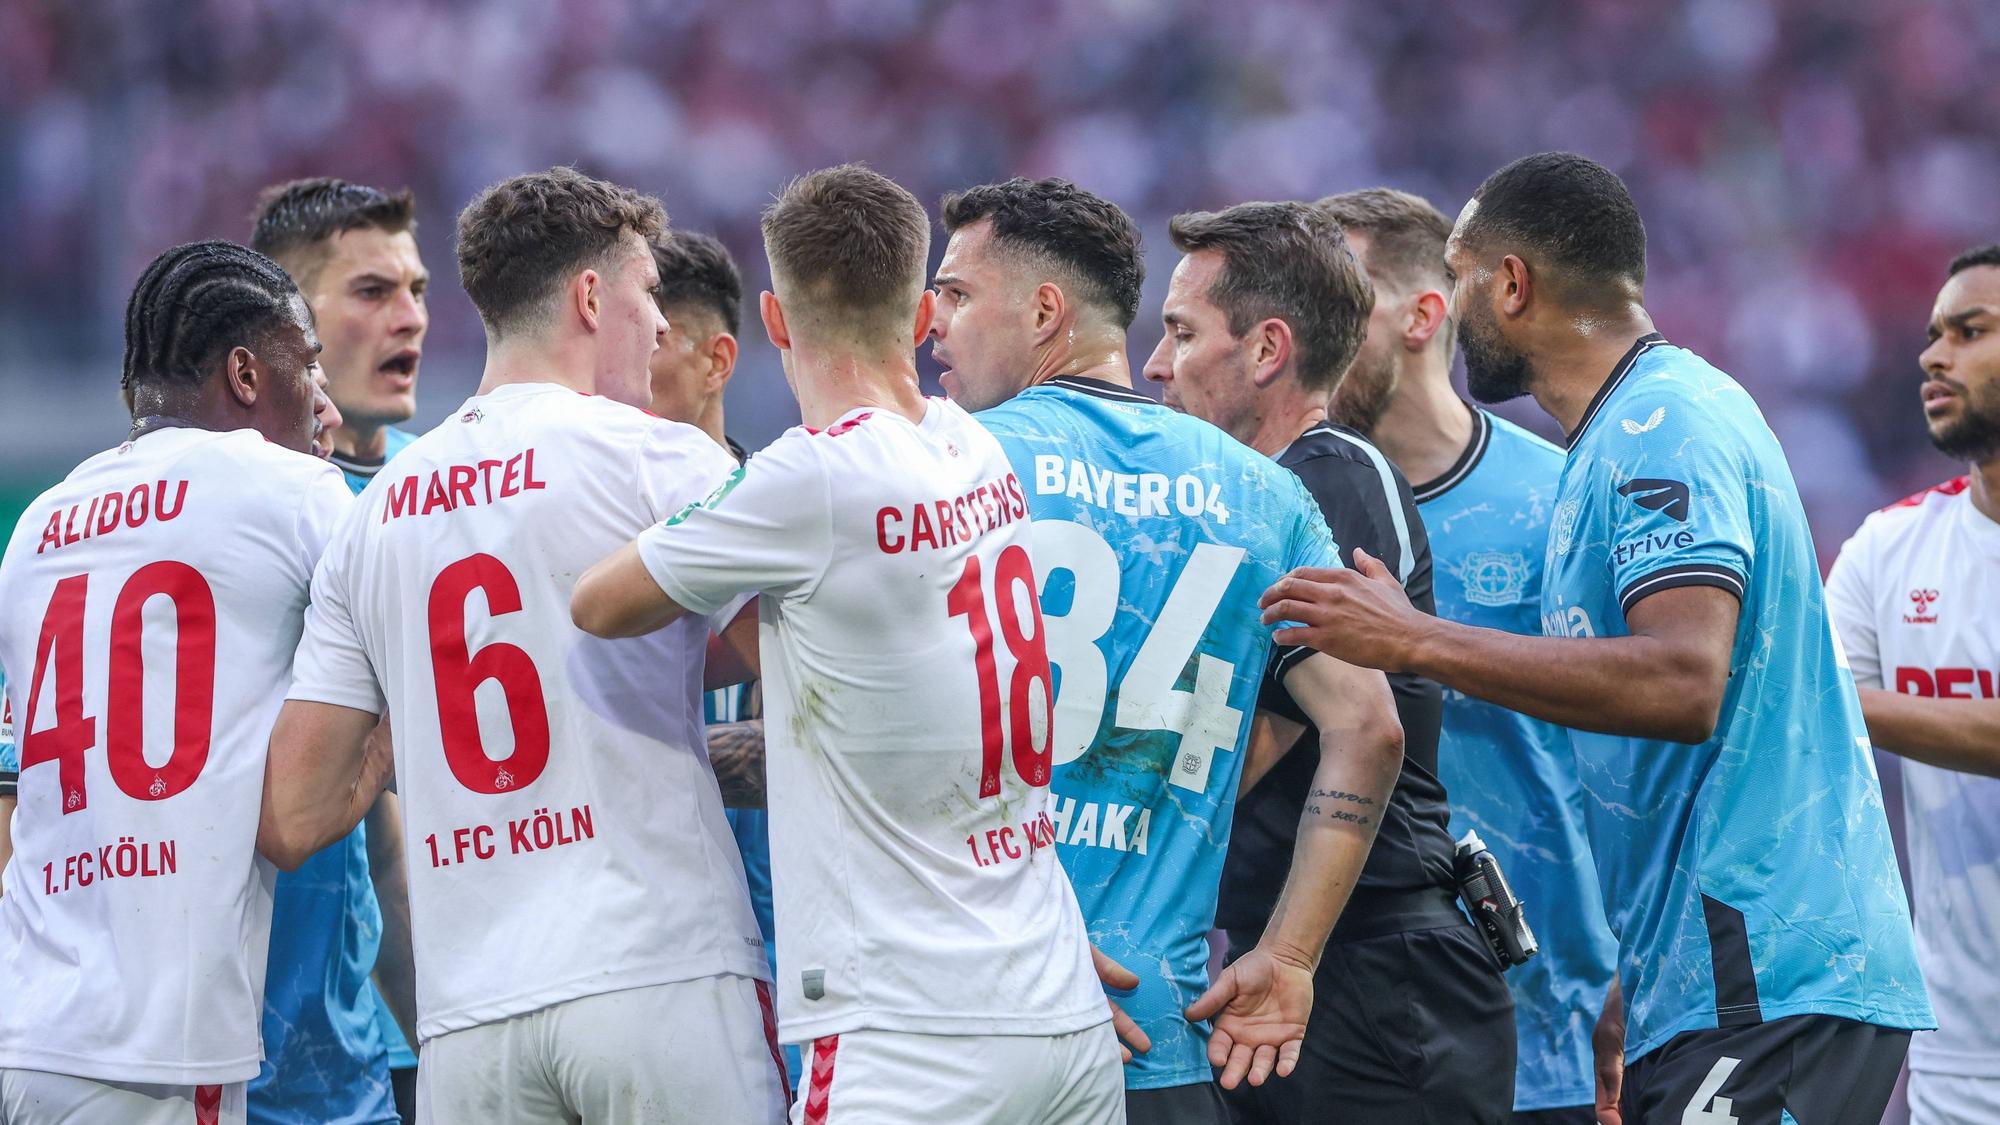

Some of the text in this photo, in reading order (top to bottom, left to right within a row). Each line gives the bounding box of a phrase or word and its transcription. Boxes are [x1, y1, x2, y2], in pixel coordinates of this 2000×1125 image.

[37, 480, 189, 554] ALIDOU
[382, 448, 546, 525] MARTEL
[876, 472, 1030, 554] CARSTENS
[1035, 454, 1171, 516] BAYER
[1613, 531, 1694, 566] trive
[21, 560, 216, 815] 40
[427, 552, 551, 794] 6
[947, 545, 1053, 799] 18
[425, 805, 595, 868] 1.FC KÖLN
[966, 827, 1021, 867] 1.FC
[1050, 793, 1151, 856] HAKA
[43, 836, 177, 896] 1.FC KÖLN
[1681, 1056, 1742, 1125] 4
